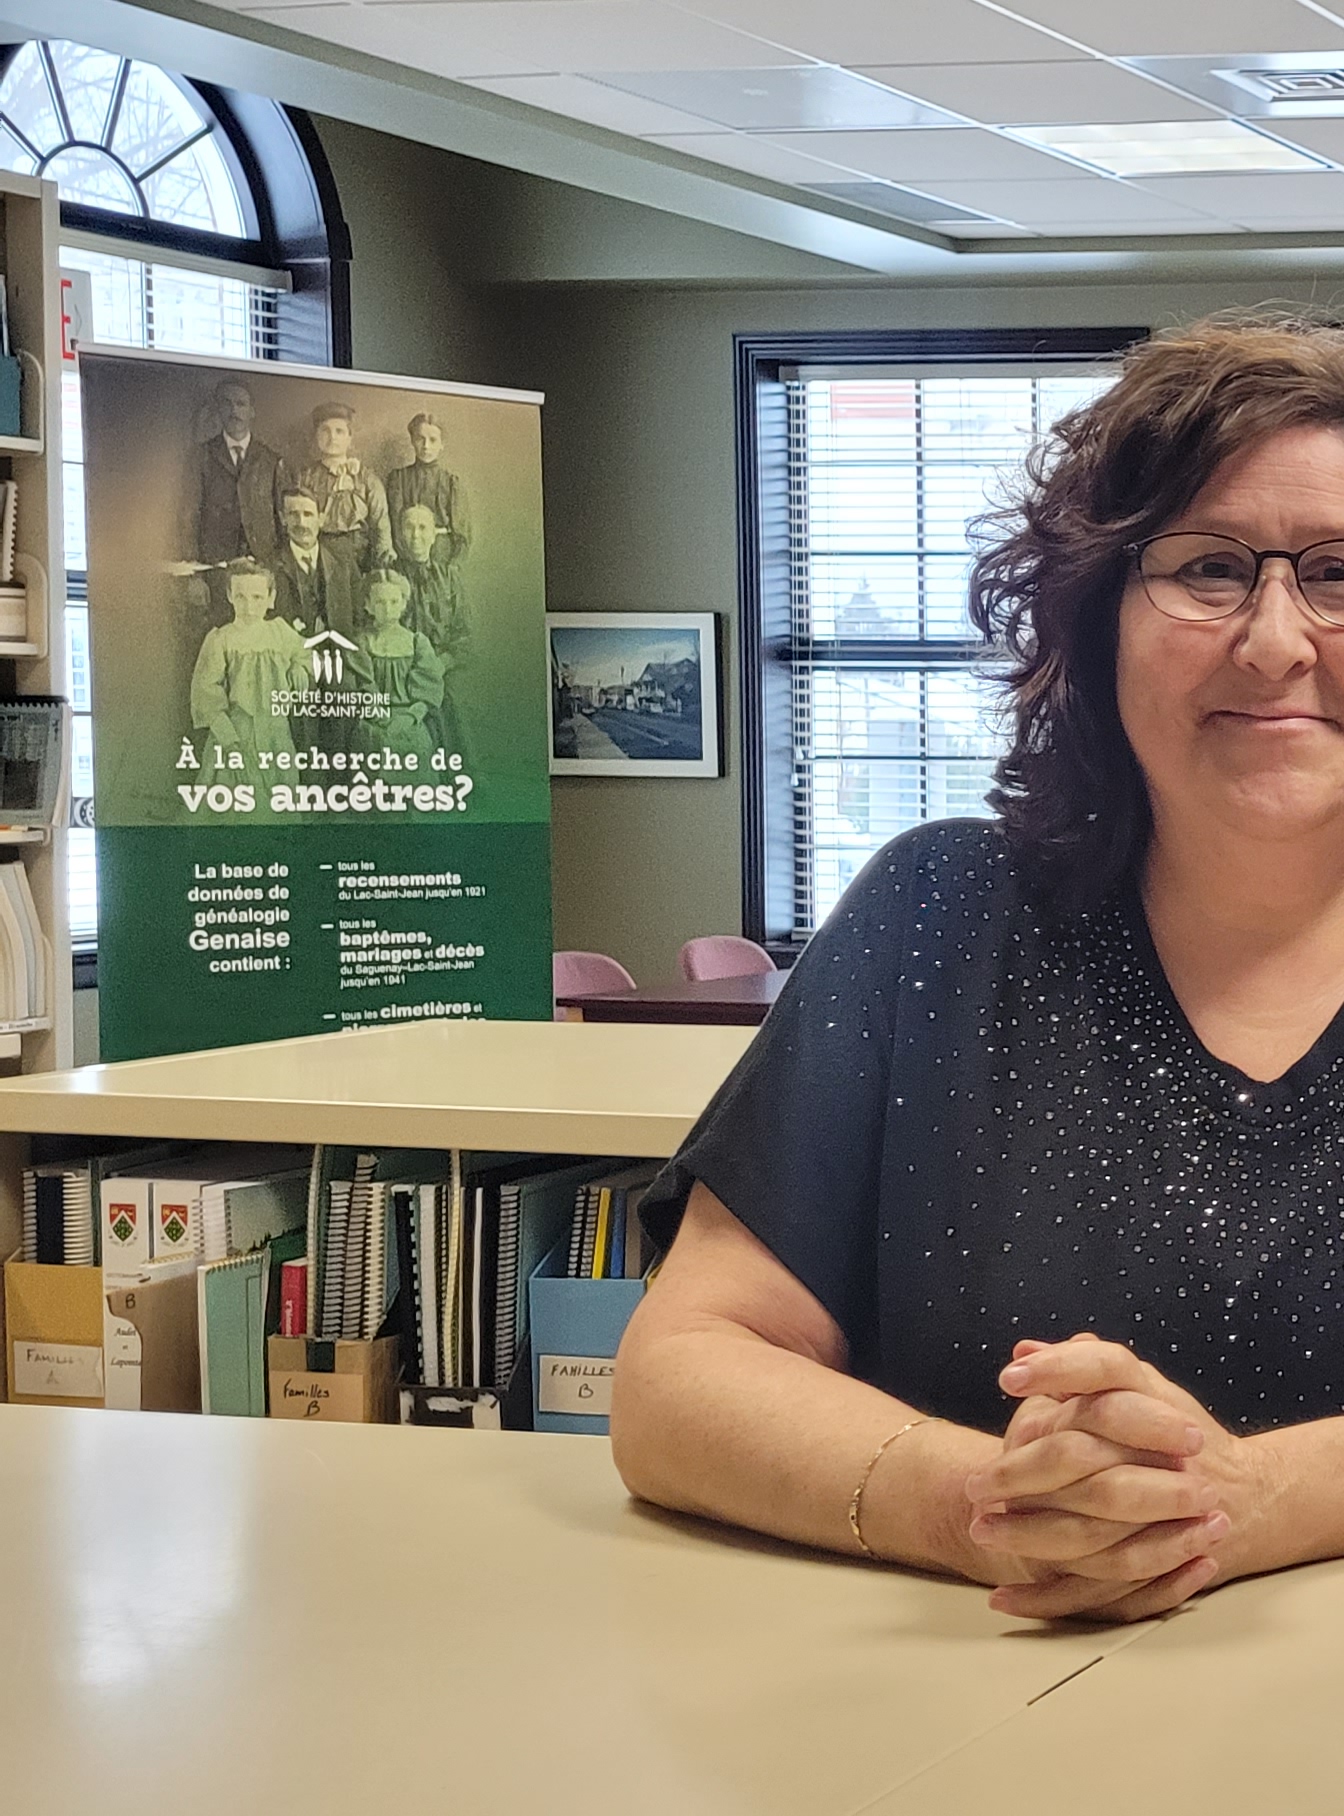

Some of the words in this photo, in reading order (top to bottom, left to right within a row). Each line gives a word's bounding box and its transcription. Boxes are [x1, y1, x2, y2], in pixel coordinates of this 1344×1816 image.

[271, 688, 322, 704] SOCIÉTÉ
[324, 690, 391, 706] D'HISTOIRE
[271, 704, 290, 717] DU
[293, 704, 391, 719] LAC-SAINT-JEAN
[175, 736, 200, 770] À
[214, 745, 245, 770] la
[258, 746, 419, 771] recherche
[431, 747, 464, 772] de
[177, 783, 256, 813] vos
[270, 771, 474, 812] ancêtres?
[194, 863, 217, 879] La
[221, 862, 264, 878] base
[268, 862, 289, 878] de
[338, 861, 359, 871] tous
[361, 860, 375, 871] les
[338, 871, 462, 888] recensements
[187, 884, 264, 902] données
[268, 884, 290, 900] de
[338, 889, 351, 901] du
[194, 906, 291, 928] généalogie
[339, 918, 360, 930] tous
[362, 917, 377, 929] les
[188, 927, 291, 951] Genaise
[340, 930, 433, 948] baptêmes,
[340, 947, 422, 964] mariages
[435, 942, 485, 959] décès
[209, 955, 281, 973] contient
[340, 965, 353, 976] du
[341, 1011, 363, 1022] tous
[364, 1009, 379, 1020] les
[380, 1000, 472, 1019] cimetières
[578, 1383, 594, 1399] B
